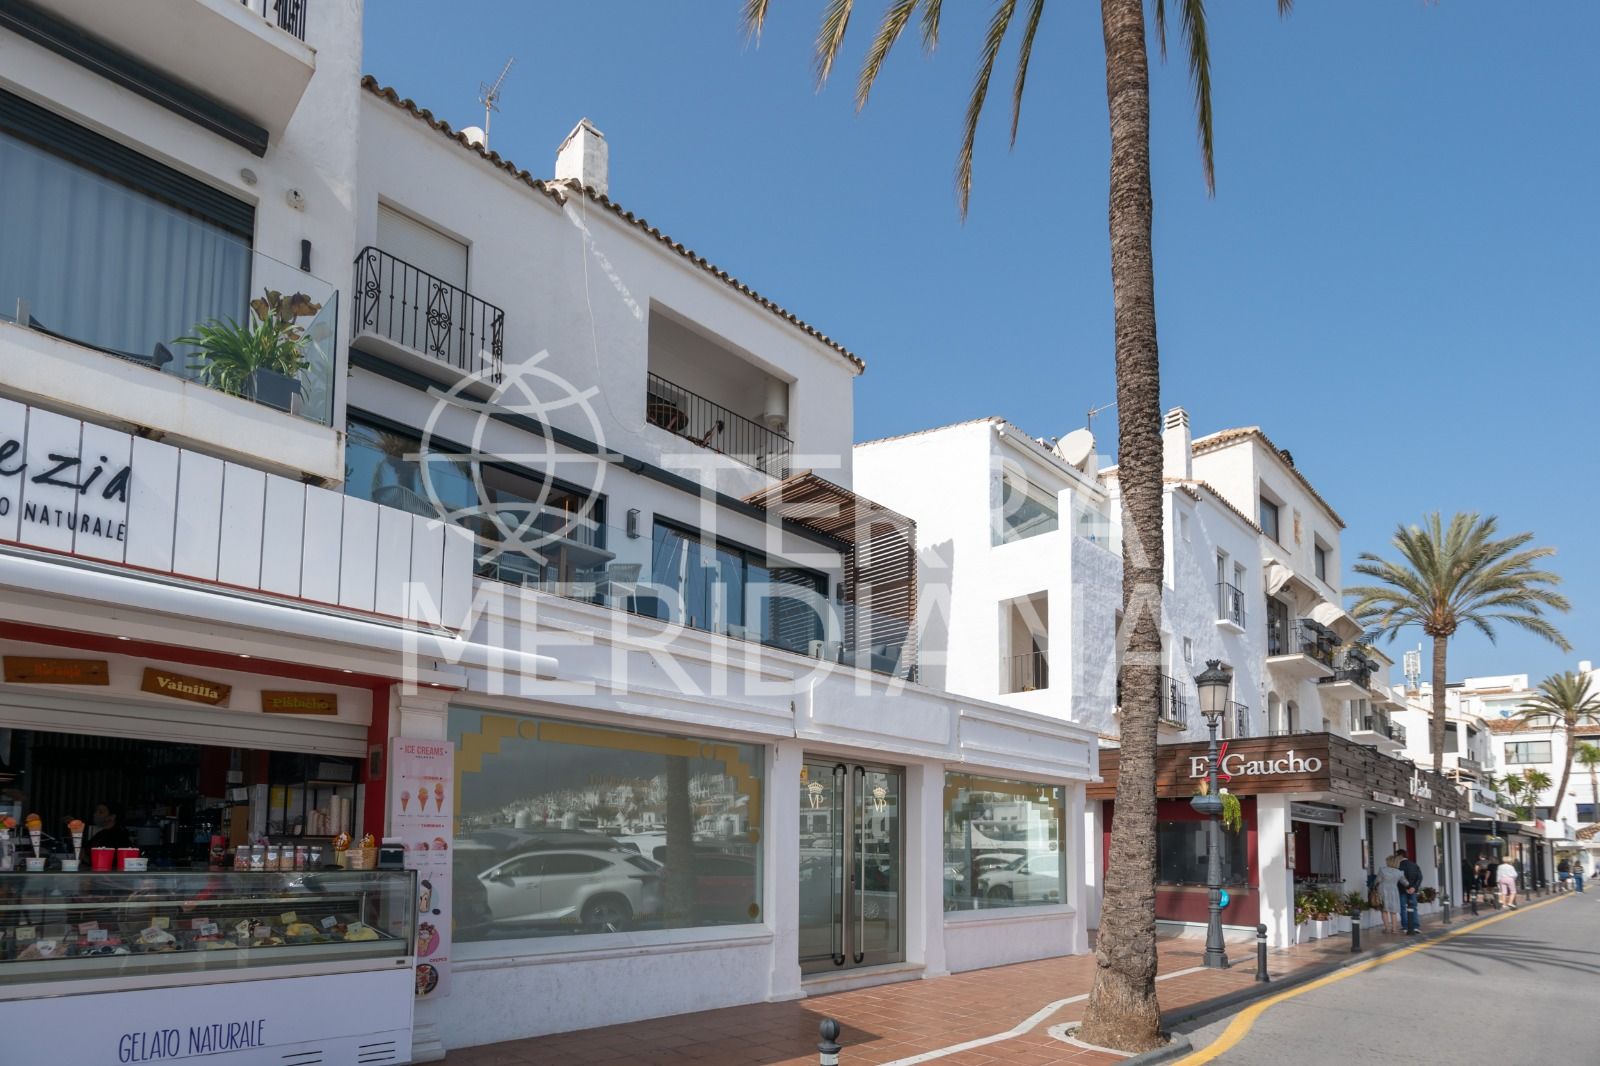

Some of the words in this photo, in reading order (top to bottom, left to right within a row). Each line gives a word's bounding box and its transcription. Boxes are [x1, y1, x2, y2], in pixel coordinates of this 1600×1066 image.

[24, 502, 127, 541] NATURALE
[157, 676, 219, 700] Vainilla
[404, 745, 416, 754] ICE
[416, 745, 445, 757] CREAMS
[1221, 749, 1323, 777] Gaucho
[118, 1028, 181, 1064] GELATO
[188, 1018, 266, 1055] NATURALE
